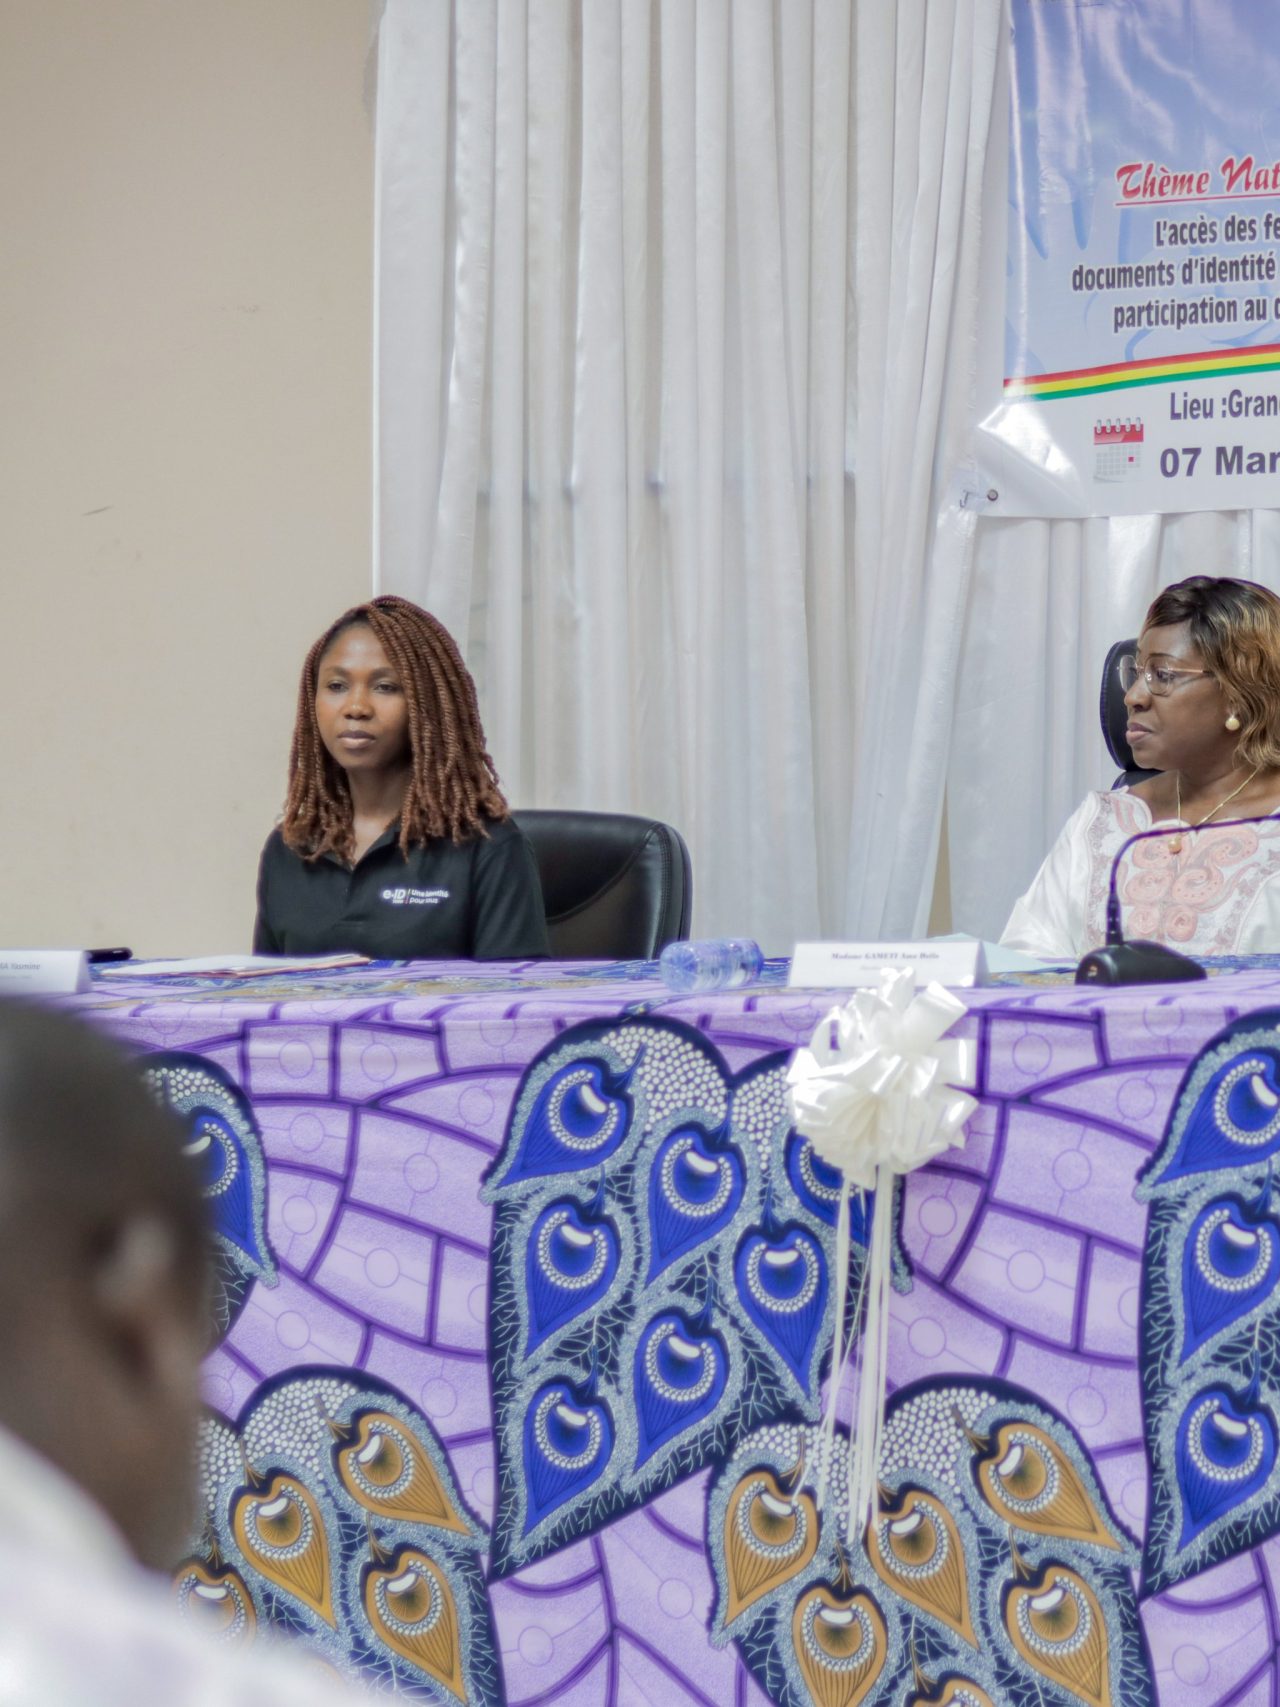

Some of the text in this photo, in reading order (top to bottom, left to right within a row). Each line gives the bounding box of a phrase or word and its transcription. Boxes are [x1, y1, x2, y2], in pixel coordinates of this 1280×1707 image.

[1116, 163, 1209, 202] Thème
[1156, 215, 1218, 247] L'accès
[1224, 215, 1257, 242] des
[1072, 262, 1175, 292] documents
[1181, 254, 1276, 285] d'identité
[1113, 296, 1238, 334] participation
[1244, 298, 1267, 322] au
[1170, 391, 1214, 421] Lieu
[1160, 447, 1202, 478] 07
